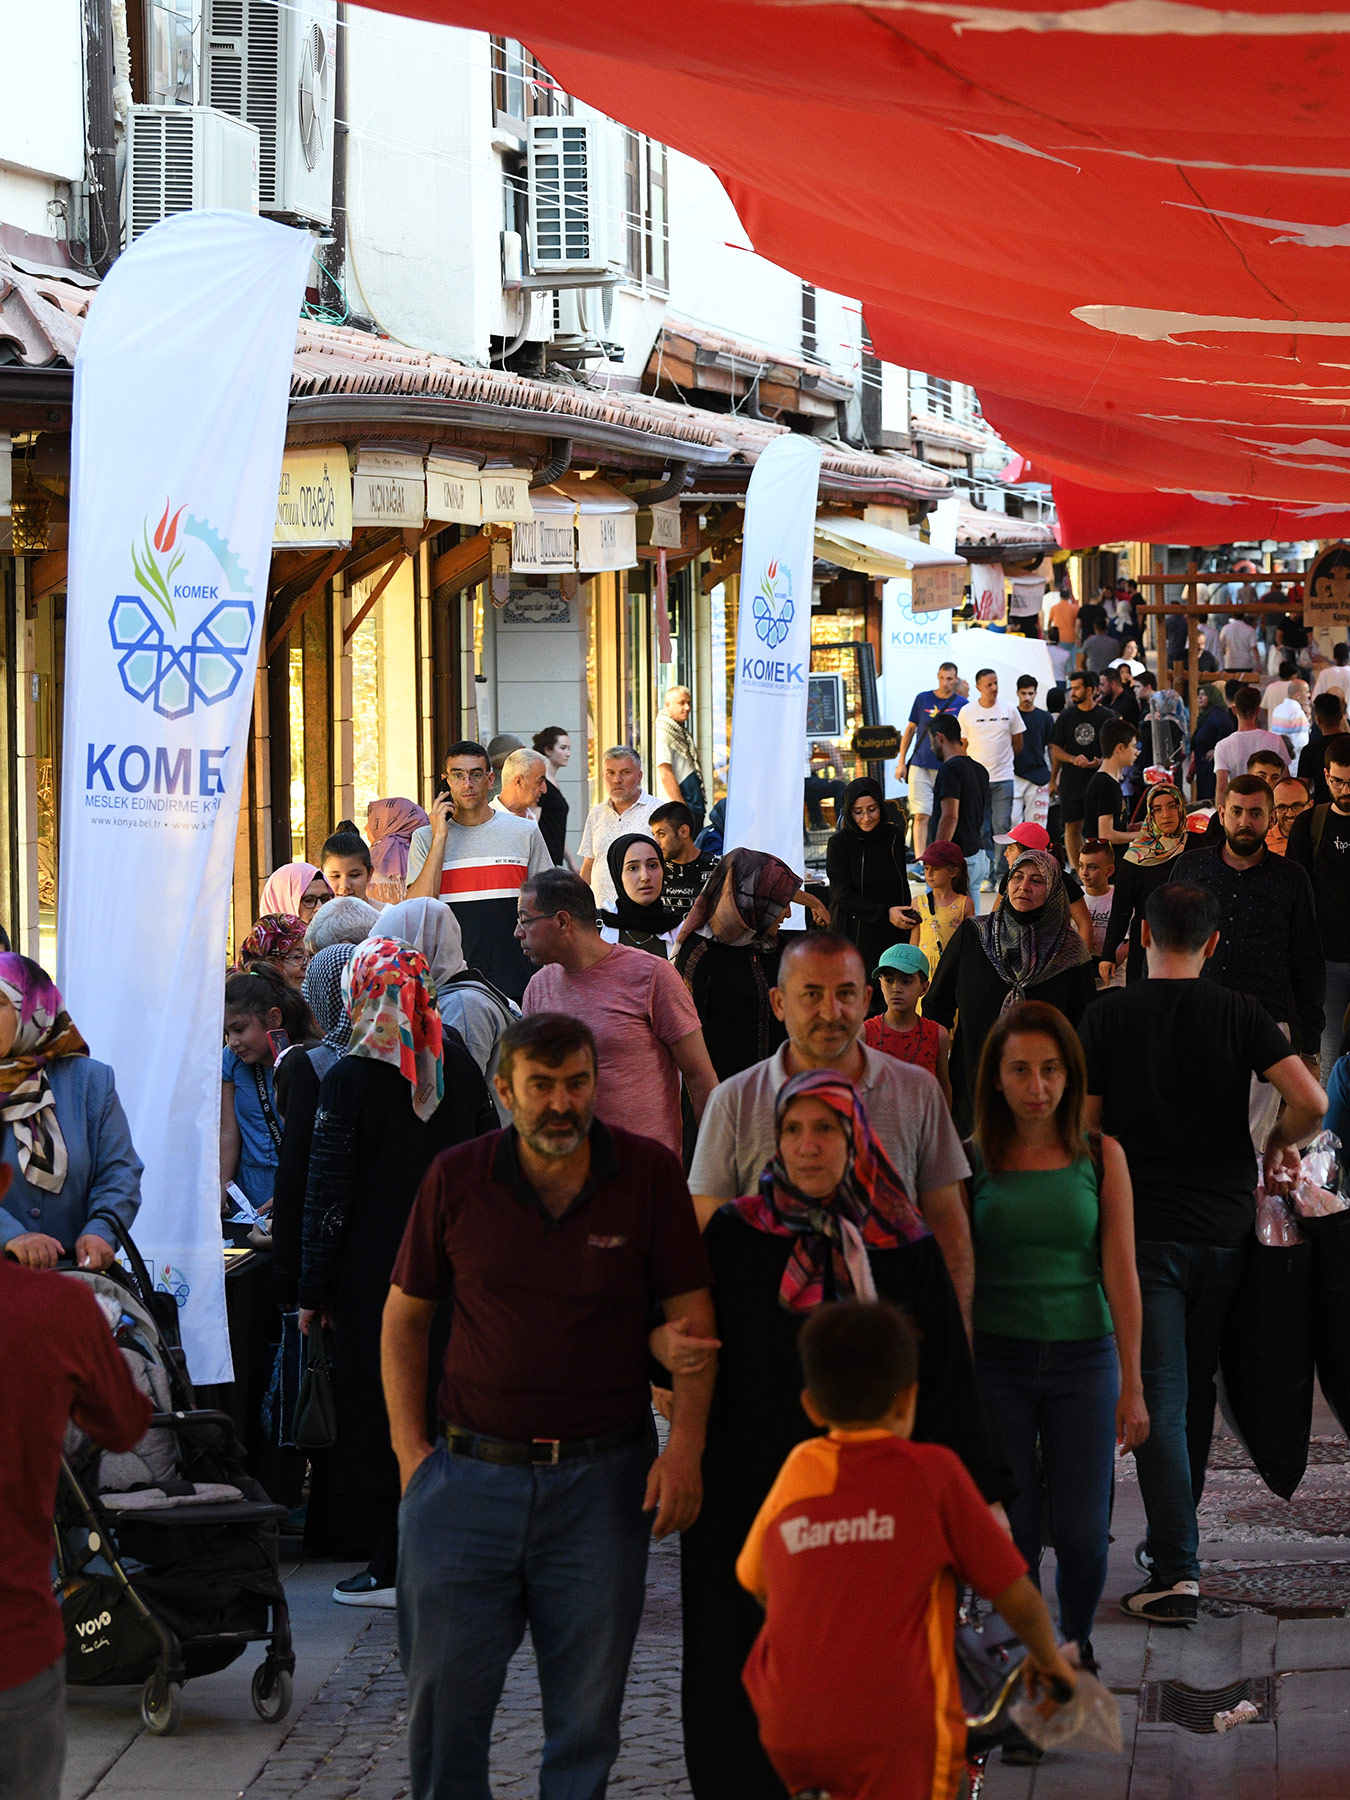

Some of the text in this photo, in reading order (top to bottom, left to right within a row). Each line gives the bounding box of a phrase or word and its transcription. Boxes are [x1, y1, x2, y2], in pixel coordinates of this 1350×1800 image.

[174, 585, 219, 599] KOMEK
[891, 631, 947, 646] KOMEK
[742, 658, 804, 683] KOMEK
[85, 795, 129, 809] MESLEK
[131, 797, 199, 813] EDİNDİRME
[780, 1508, 895, 1554] Garenta
[75, 1610, 112, 1637] VOVO
